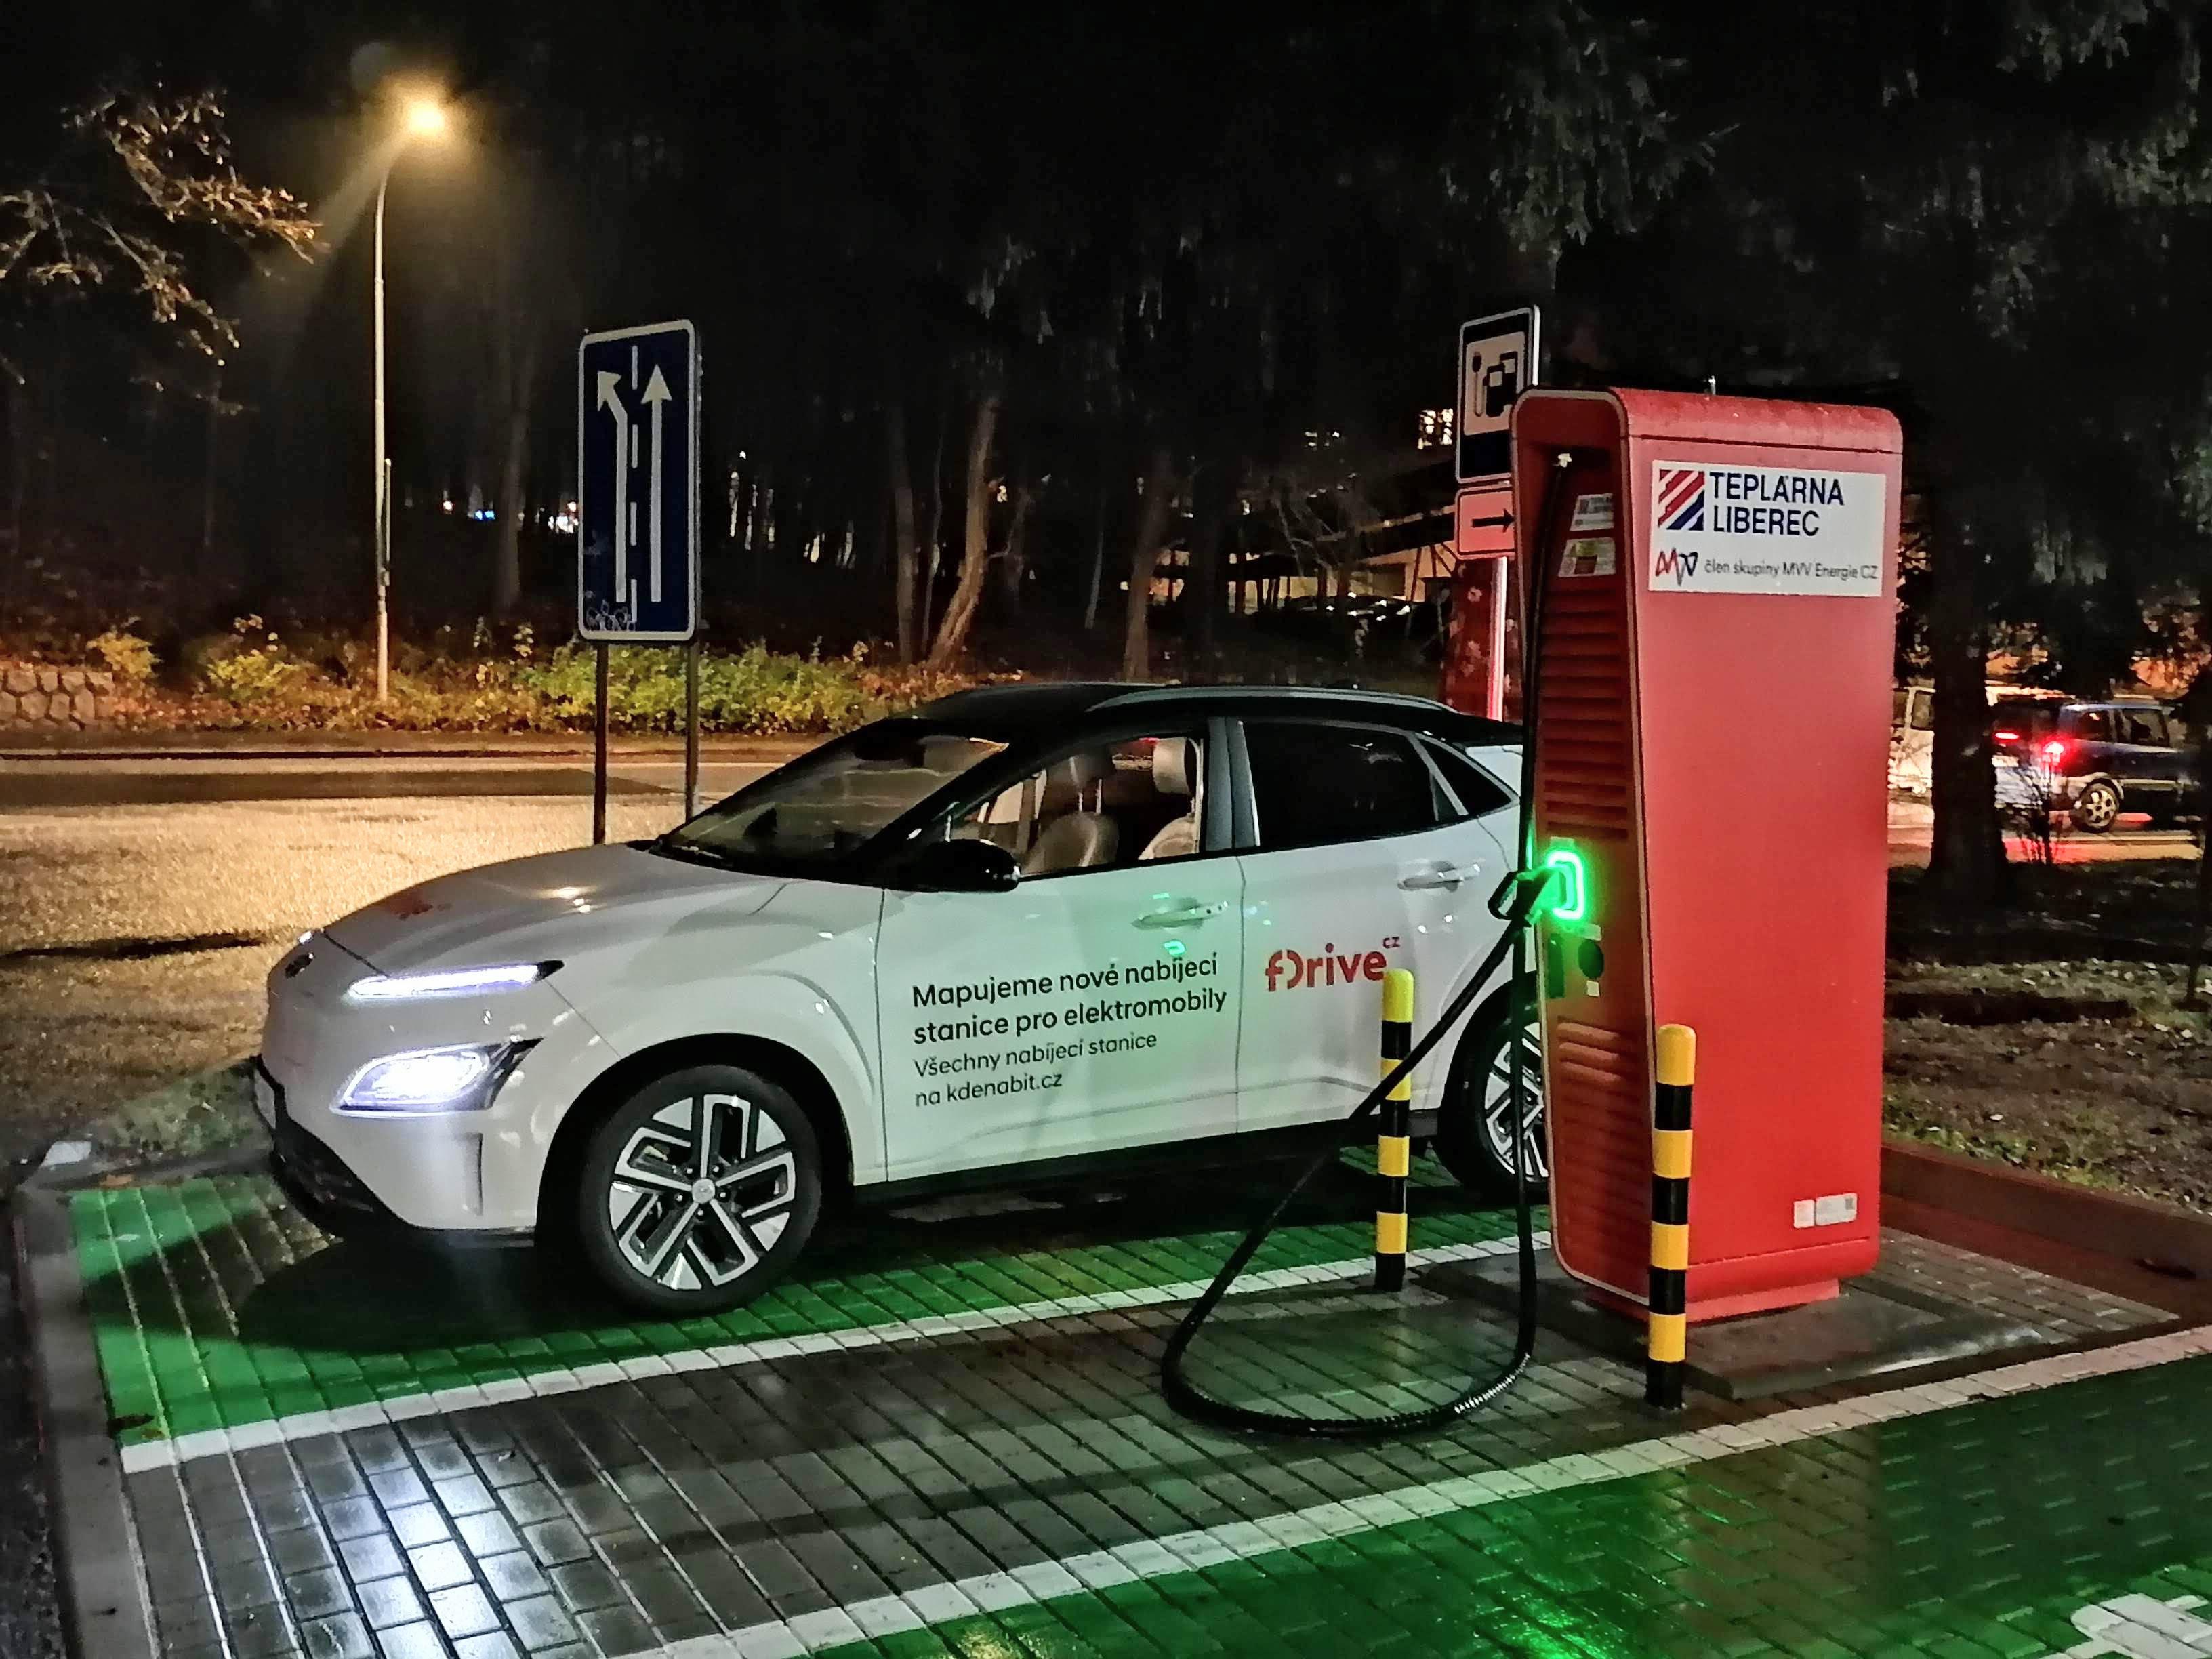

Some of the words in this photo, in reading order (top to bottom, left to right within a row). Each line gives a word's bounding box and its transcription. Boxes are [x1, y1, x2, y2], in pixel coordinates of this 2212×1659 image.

[1709, 472, 1845, 506] TEPLÁRNA
[1713, 505, 1820, 536] LIBEREC
[1704, 558, 1729, 574] člen
[1733, 559, 1780, 578] skupiny
[1815, 562, 1858, 581] Energie
[1860, 565, 1878, 579] CZ
[912, 975, 1053, 1008] Mapujeme
[1059, 963, 1119, 991] nové
[1125, 951, 1218, 984] nabíjecí
[914, 1013, 1009, 1044] stanice
[1016, 1012, 1058, 1038] pro
[1063, 988, 1227, 1026] elektromobily
[913, 1052, 1000, 1078] Všechny
[1088, 1031, 1158, 1055] stanice
[916, 1091, 941, 1107] na
[947, 1073, 1063, 1103] kdenabit.cz
